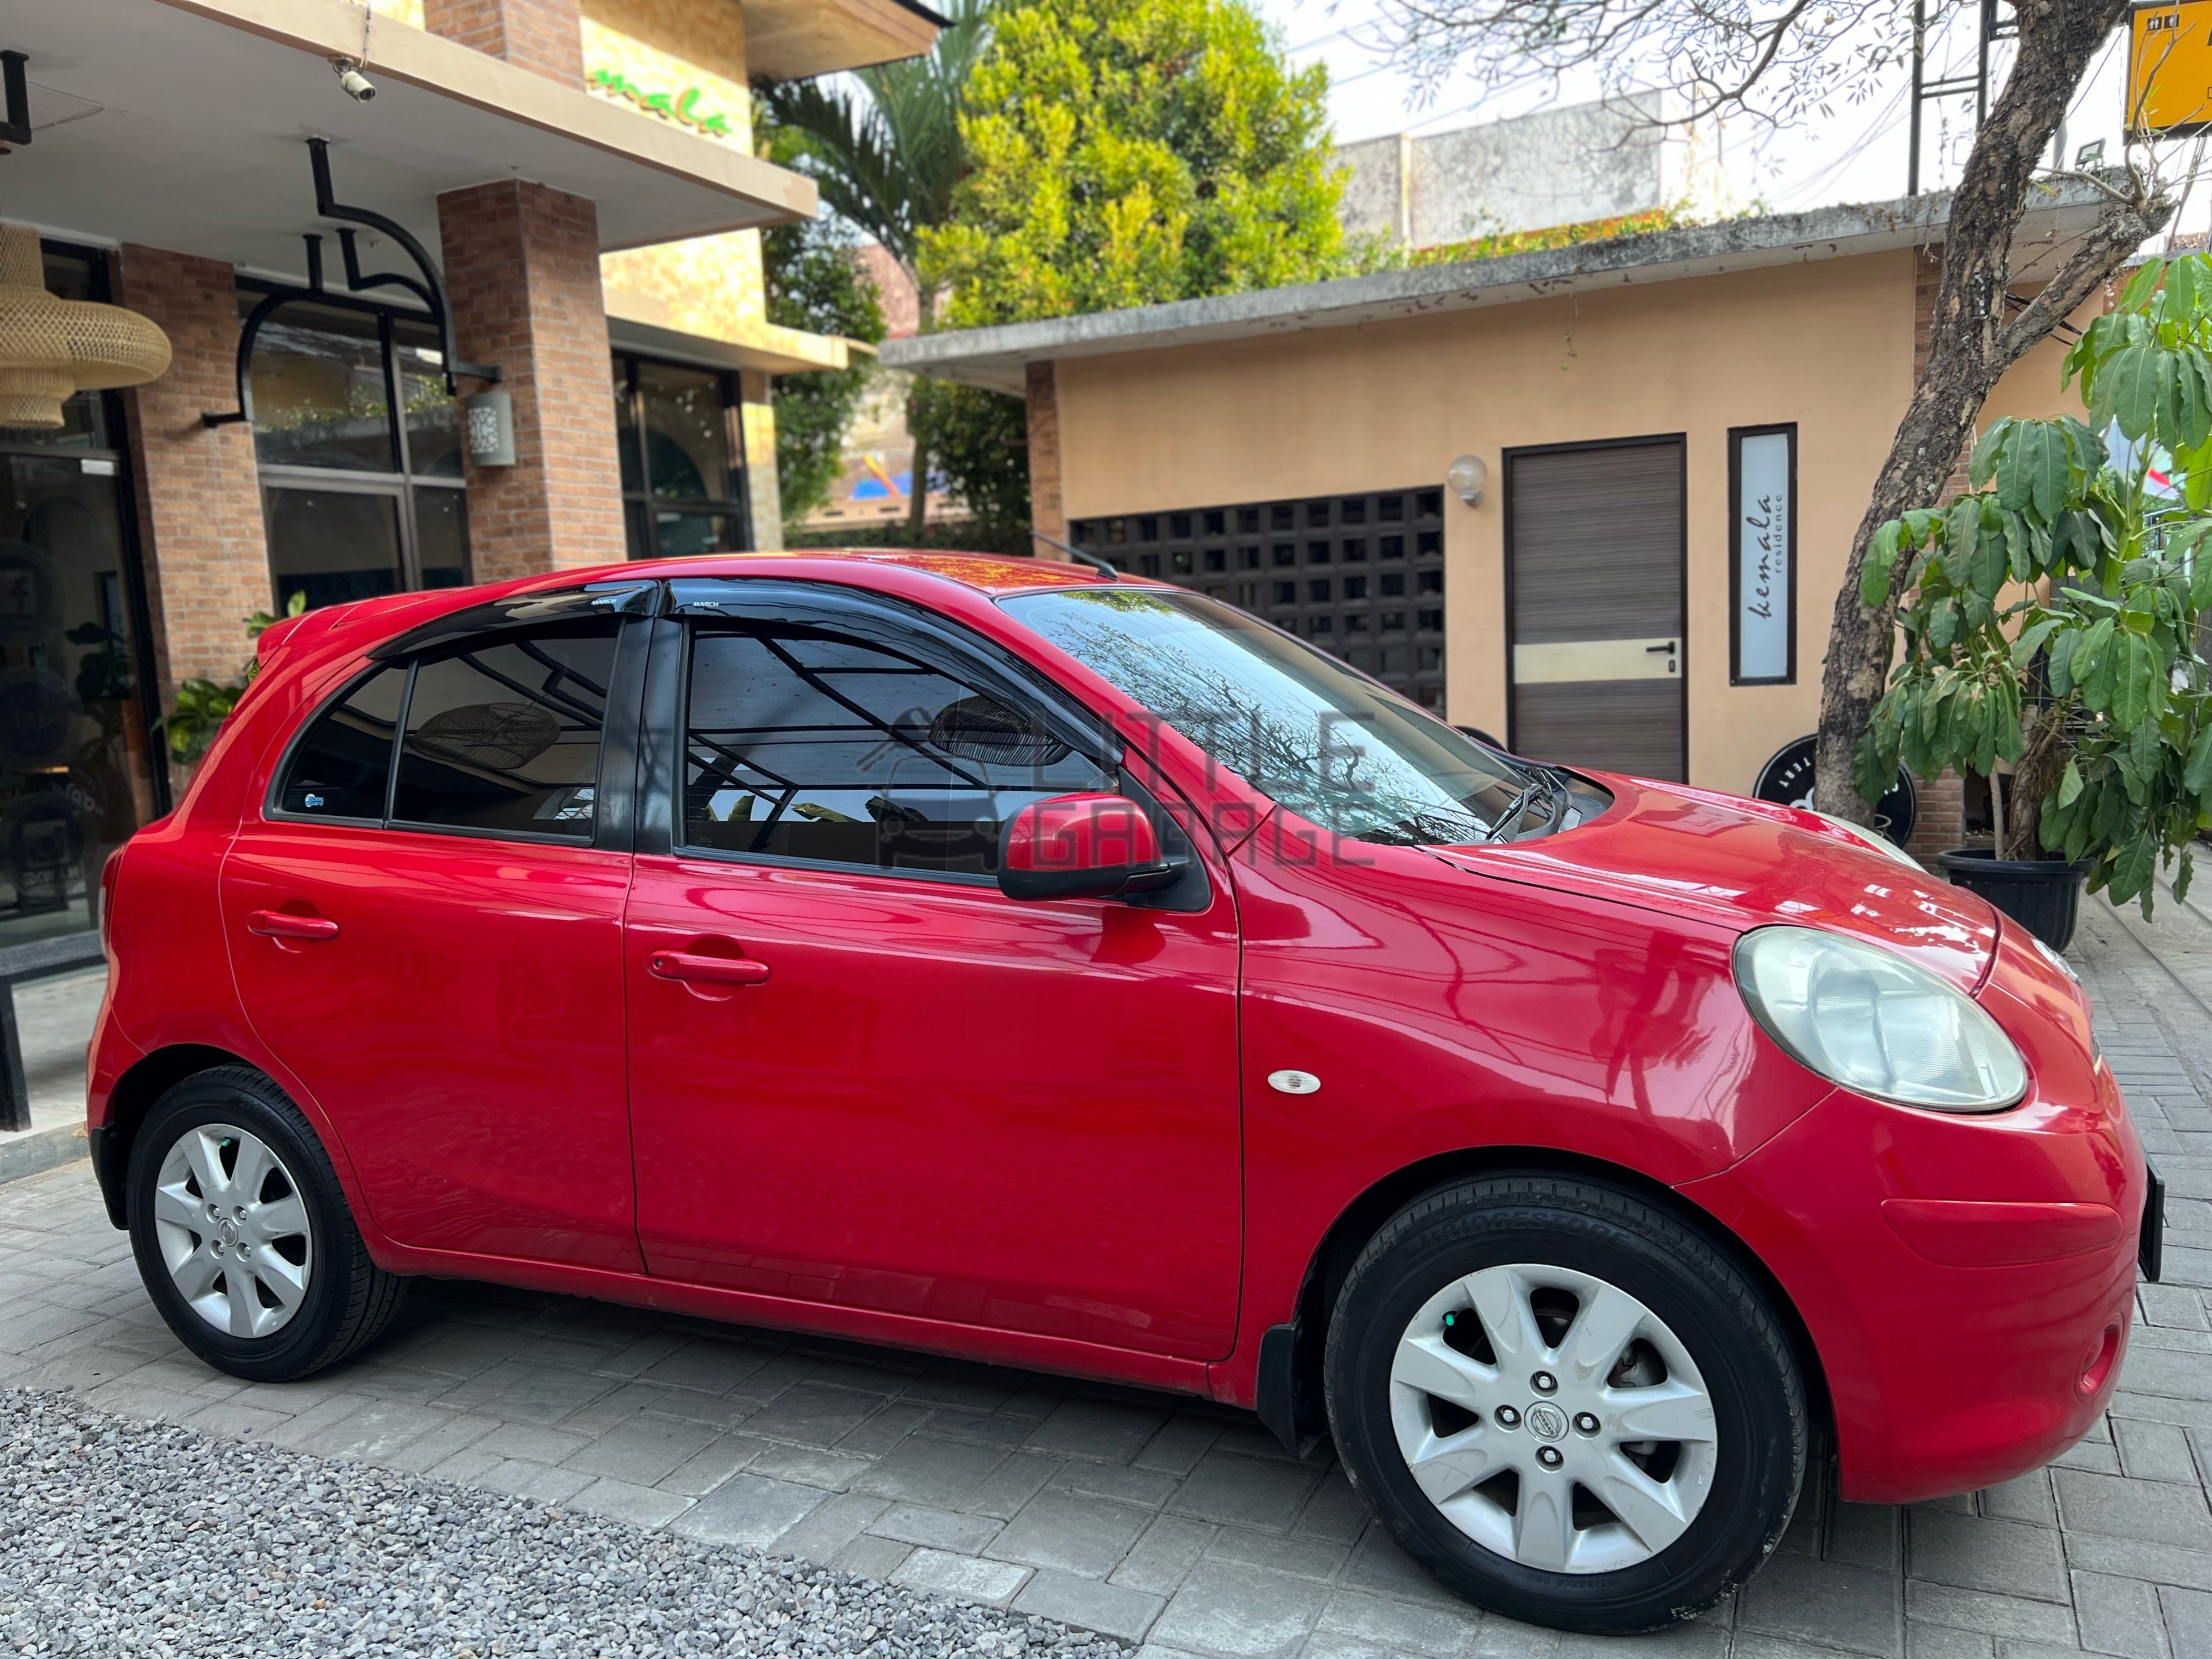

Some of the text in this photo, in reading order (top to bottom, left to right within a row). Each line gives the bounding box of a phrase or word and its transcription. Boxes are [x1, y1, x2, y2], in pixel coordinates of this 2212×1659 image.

[585, 70, 732, 138] mala
[1746, 495, 1771, 619] kemala
[1772, 494, 1783, 573] residence
[1779, 757, 1812, 788] TERY
[1538, 1410, 1555, 1435] NISSAN
